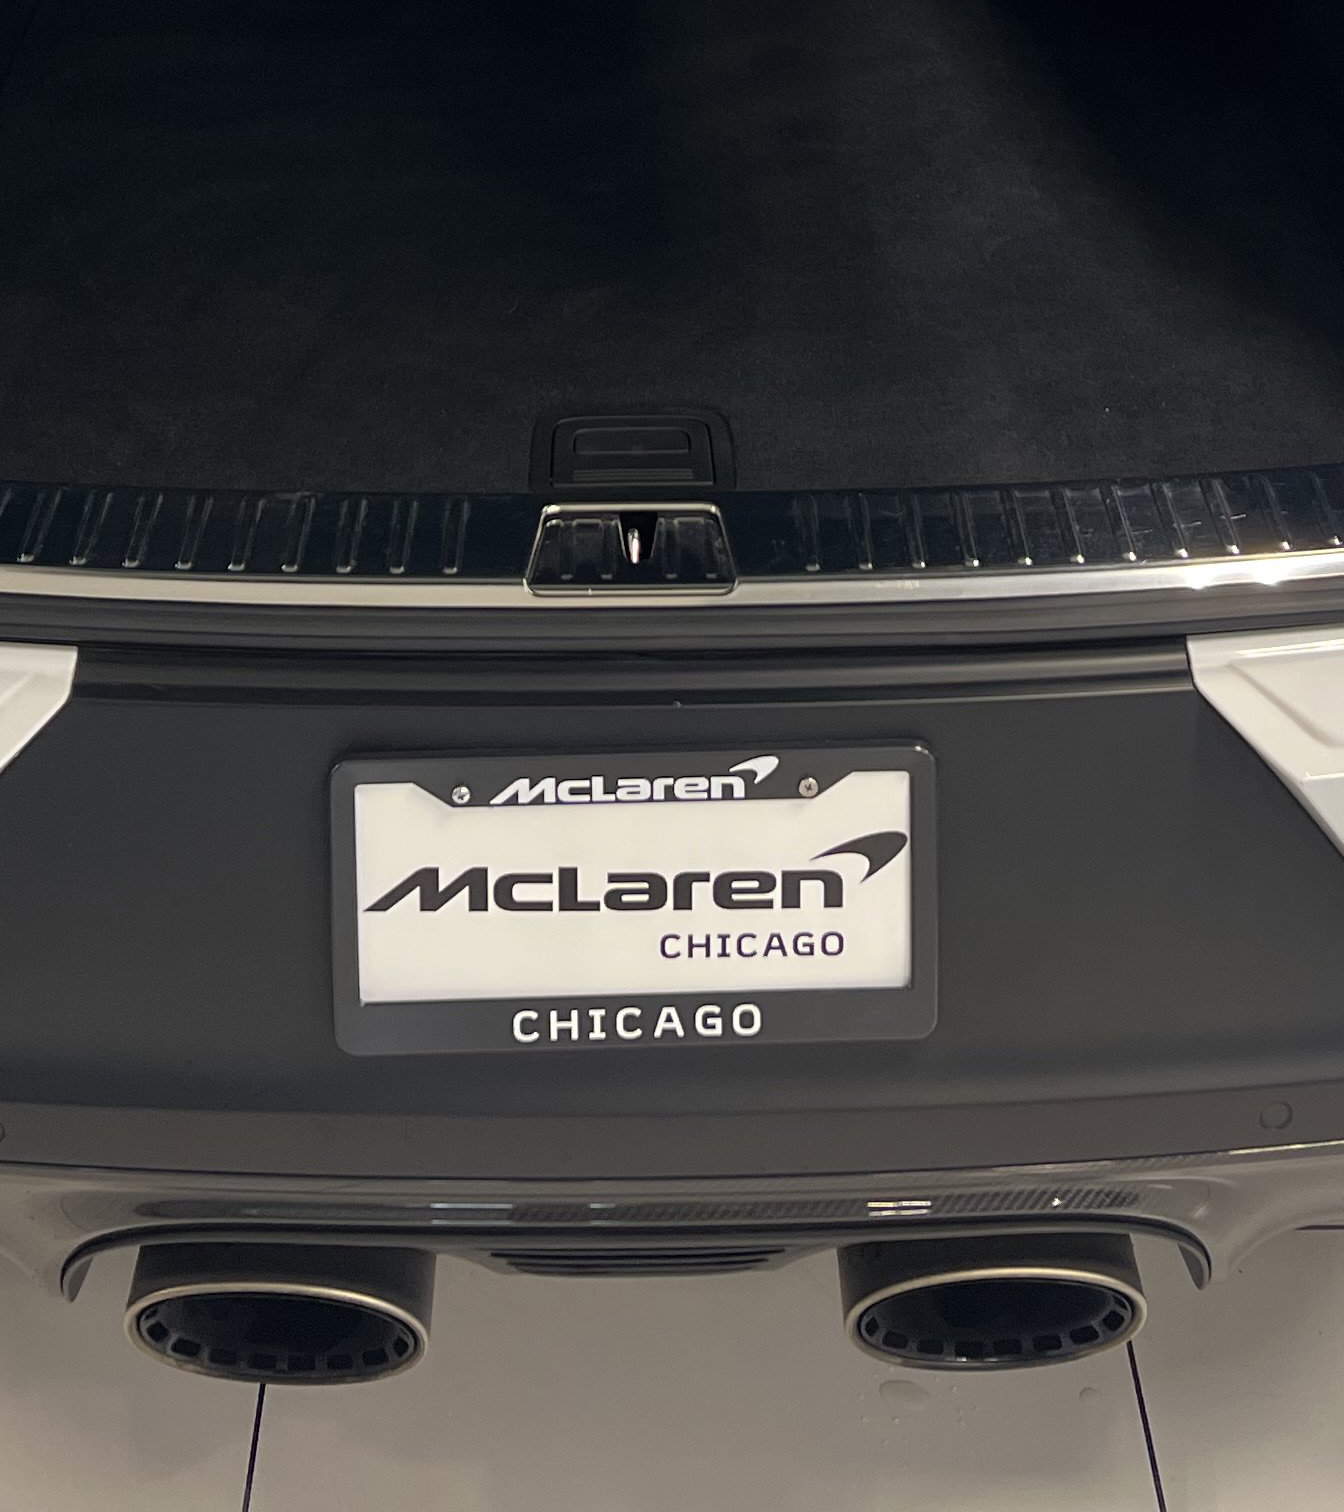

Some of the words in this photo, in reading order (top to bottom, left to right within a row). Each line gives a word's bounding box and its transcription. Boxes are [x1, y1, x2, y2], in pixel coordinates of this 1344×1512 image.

[490, 776, 745, 804] McLaren
[365, 867, 844, 912] McLaren
[660, 932, 844, 959] CHICAGO
[512, 1003, 761, 1043] CHICAGO
